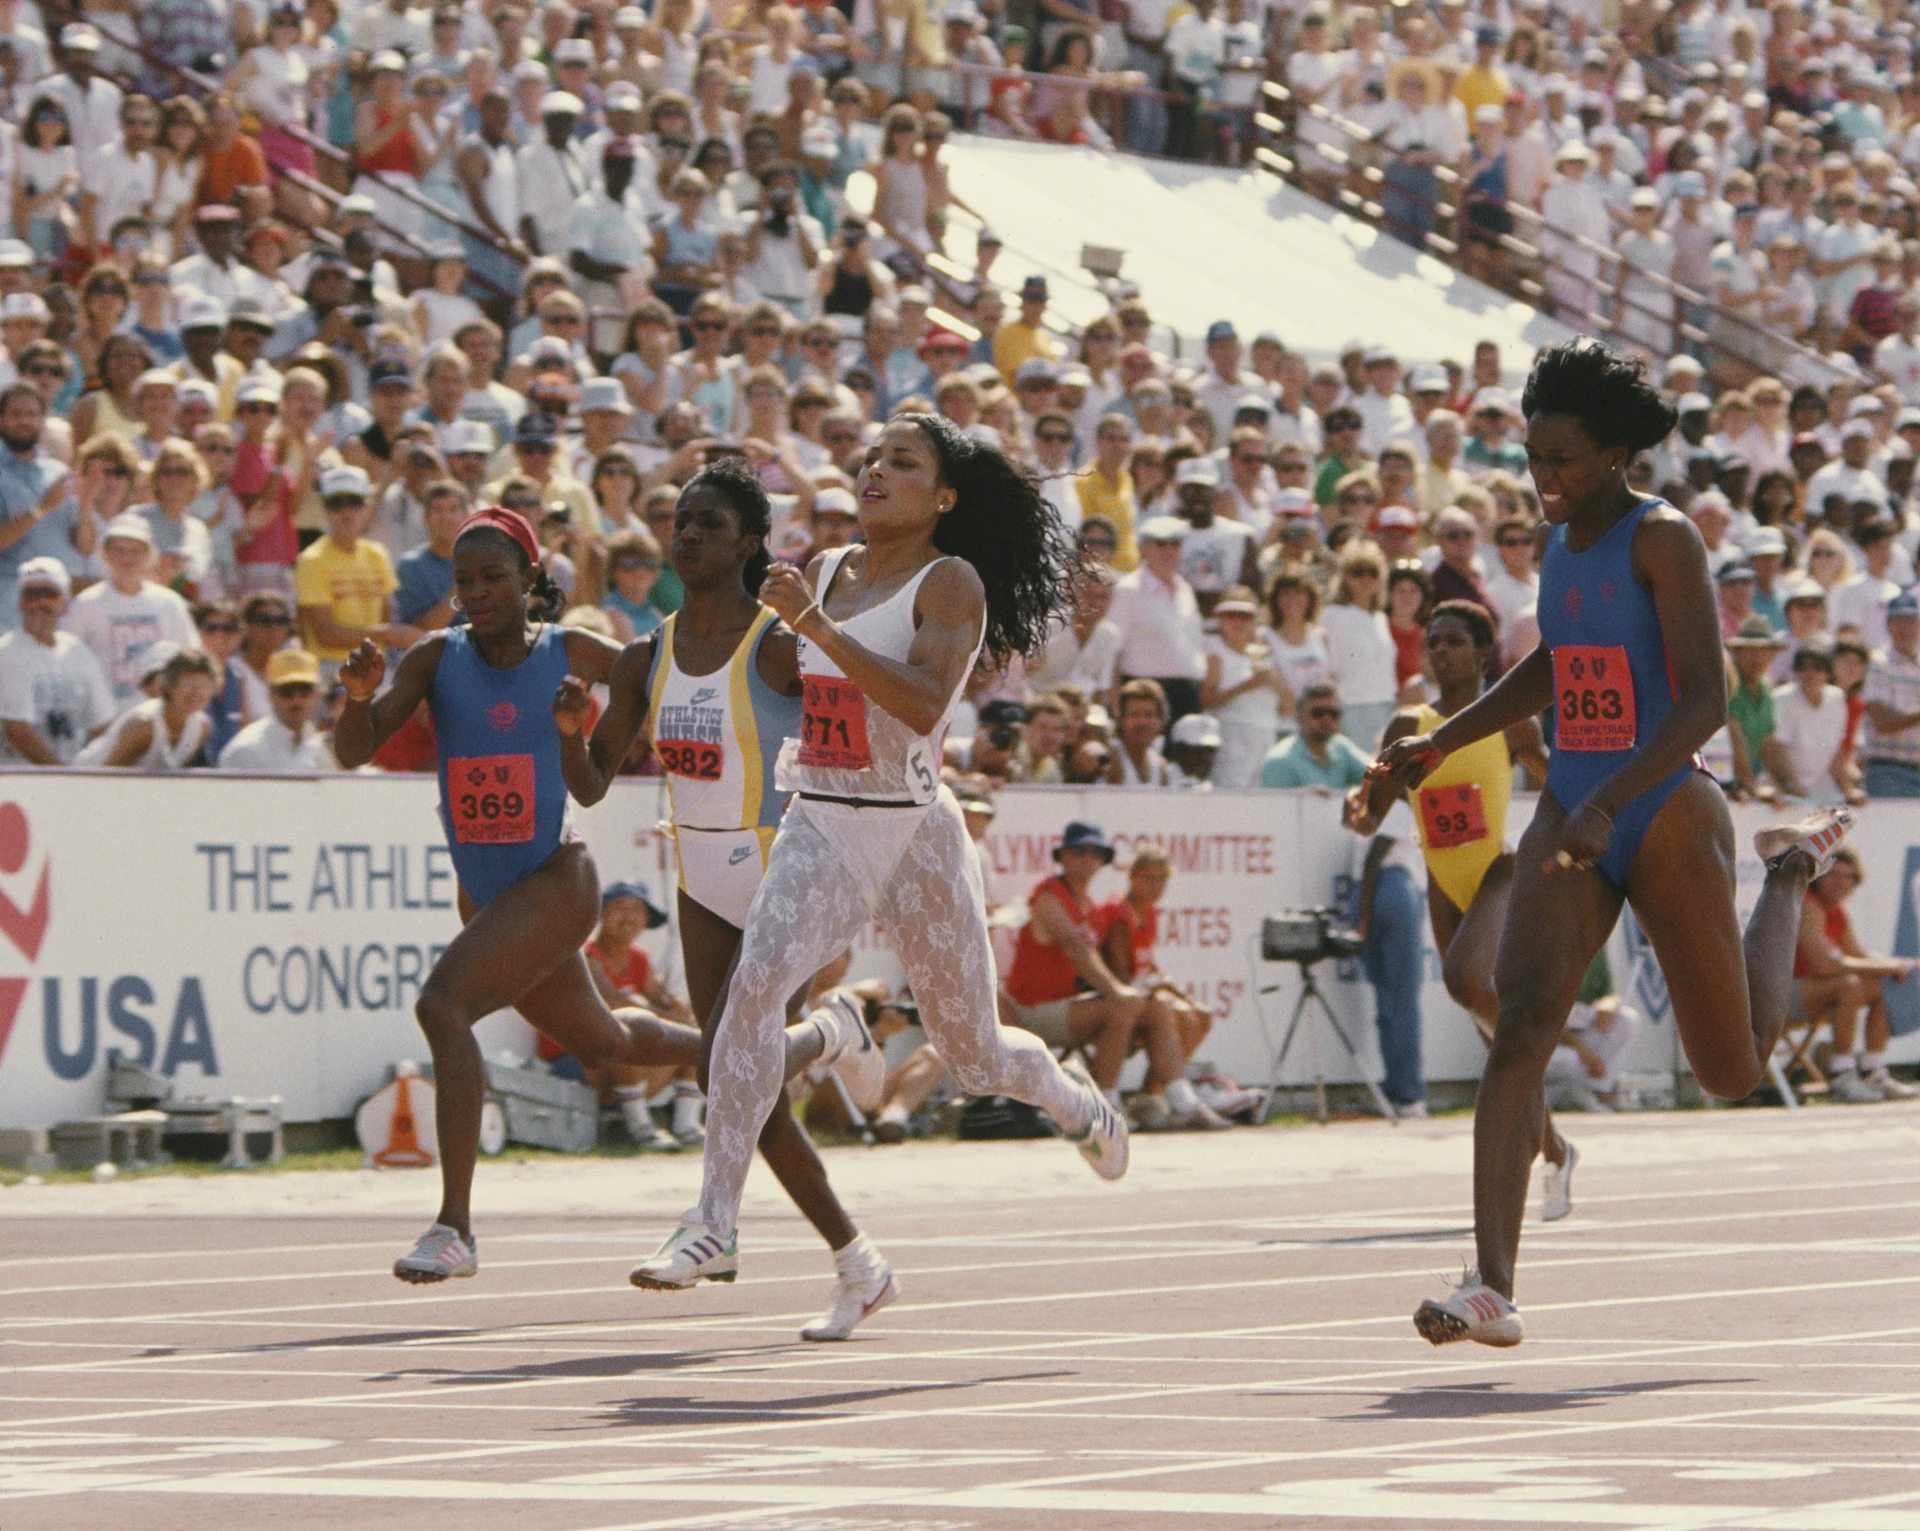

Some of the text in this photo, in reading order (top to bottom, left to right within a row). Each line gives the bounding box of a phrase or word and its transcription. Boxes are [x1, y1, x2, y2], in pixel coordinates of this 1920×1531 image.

[660, 705, 725, 726] ATHLETICS
[1563, 689, 1623, 720] 363
[804, 712, 850, 748] 371
[1587, 736, 1602, 747] AND
[1603, 724, 1634, 735] TRIALS
[660, 747, 721, 777] 382
[911, 750, 933, 793] 5
[461, 792, 523, 819] 369
[1435, 811, 1469, 833] 93
[195, 843, 292, 911] THE
[43, 975, 219, 1080] USA
